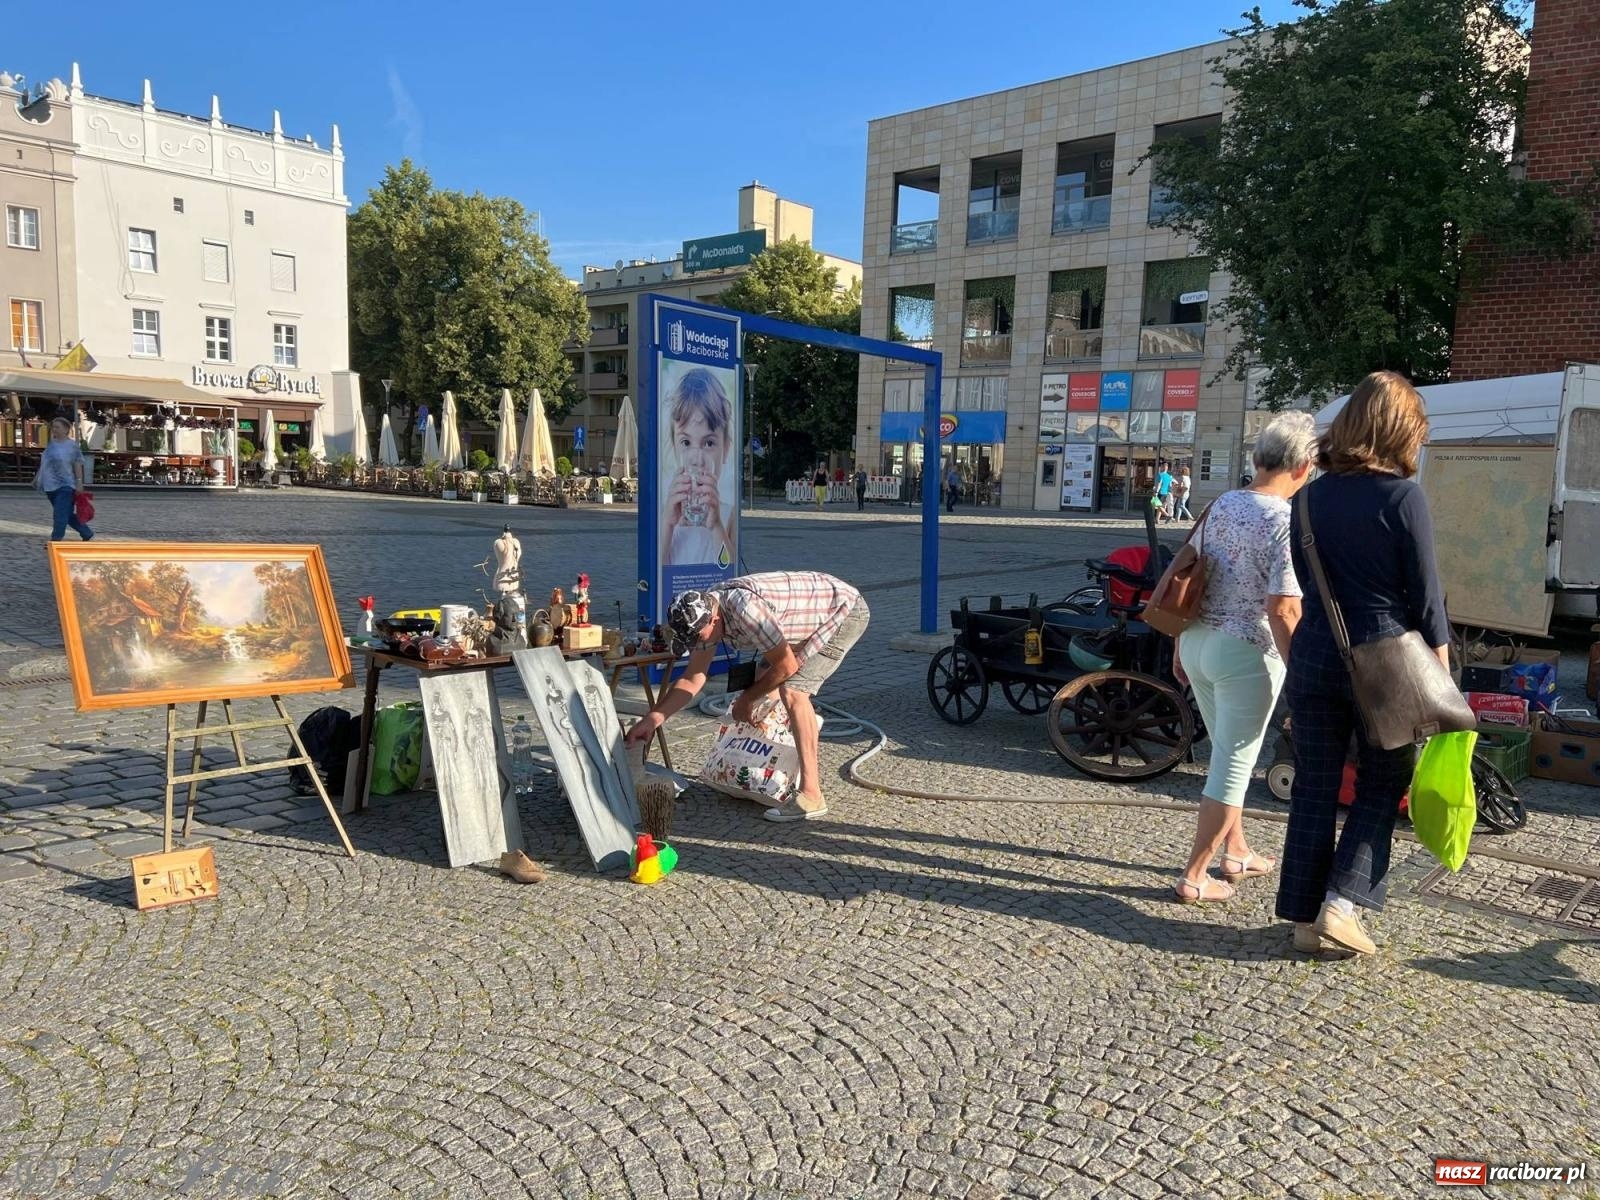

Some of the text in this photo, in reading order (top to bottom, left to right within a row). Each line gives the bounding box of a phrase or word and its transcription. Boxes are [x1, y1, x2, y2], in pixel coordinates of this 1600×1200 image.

[702, 245, 744, 259] McDonald's
[686, 329, 729, 350] Wodociągi
[686, 343, 729, 360] Raciborskie
[192, 365, 320, 394] Browar Rynek
